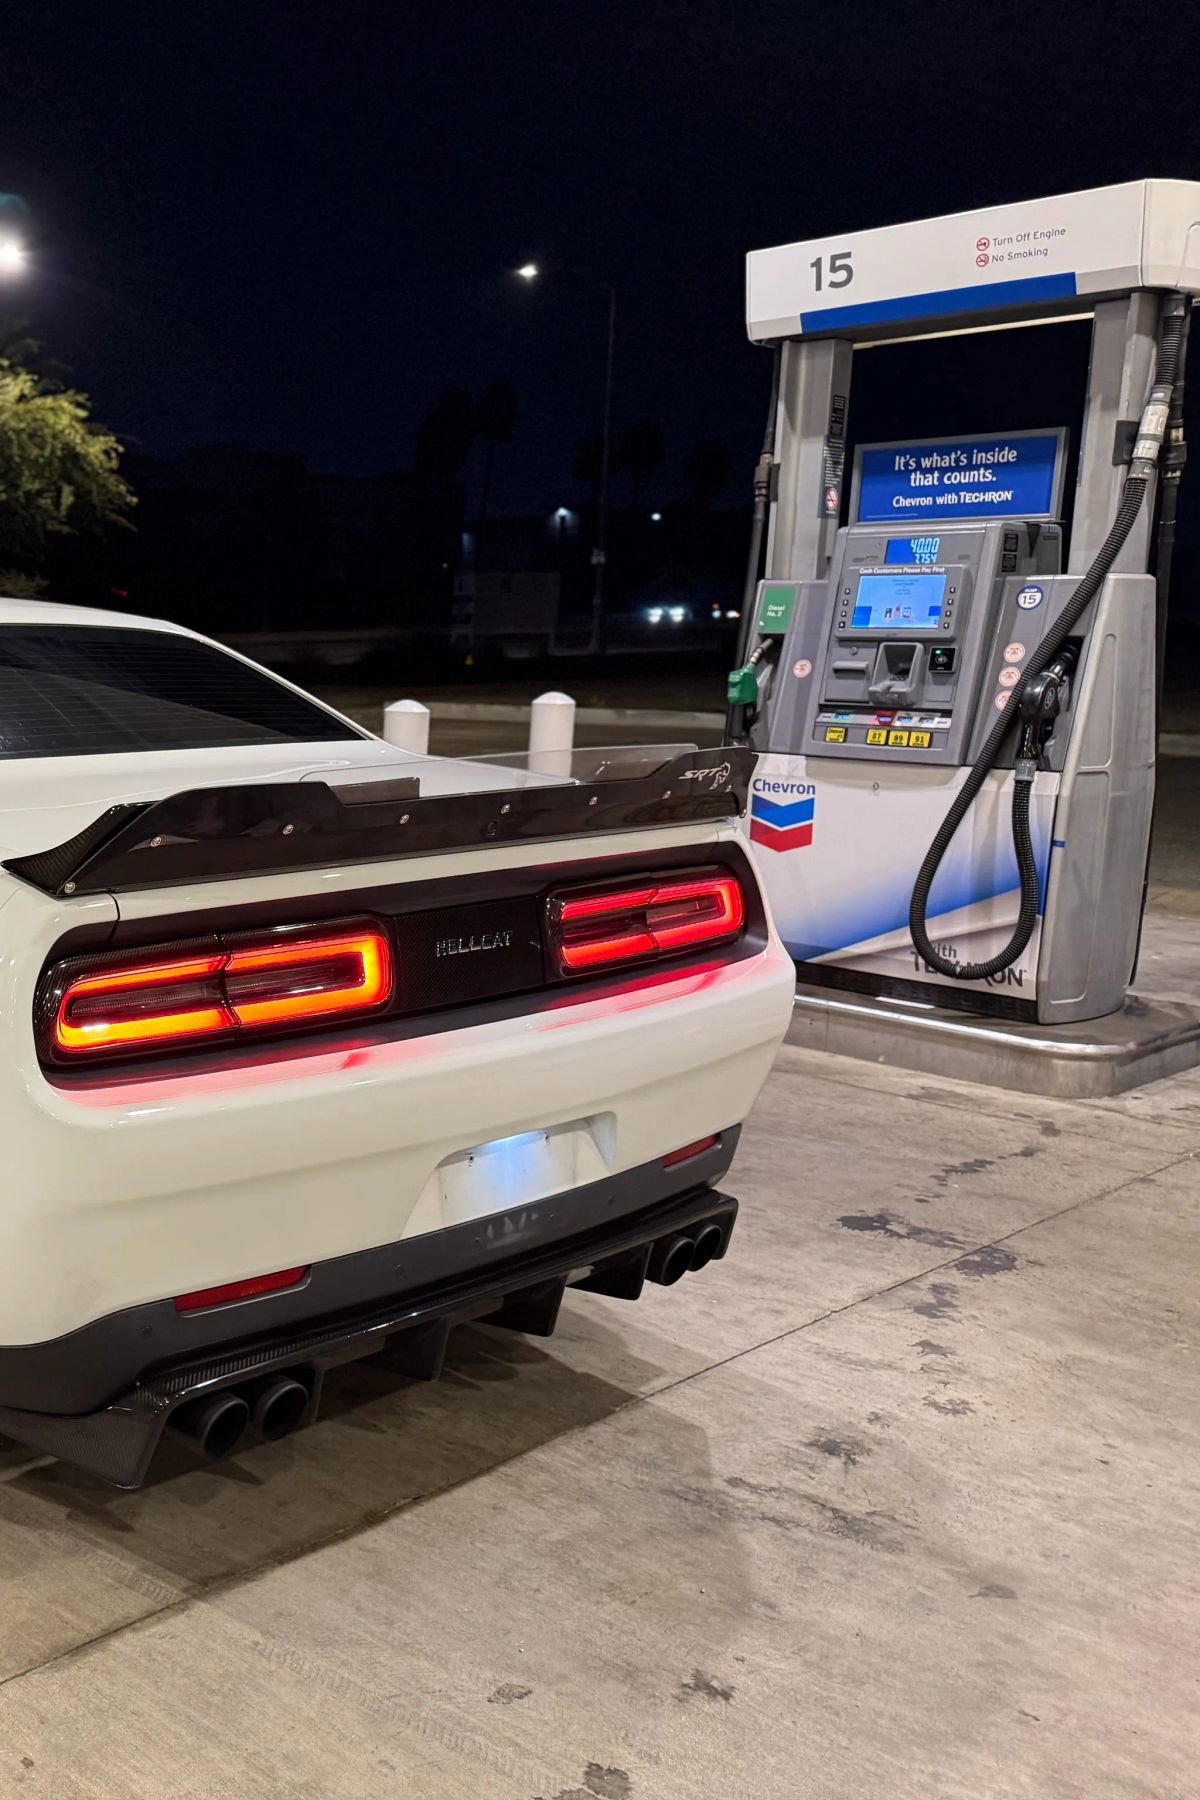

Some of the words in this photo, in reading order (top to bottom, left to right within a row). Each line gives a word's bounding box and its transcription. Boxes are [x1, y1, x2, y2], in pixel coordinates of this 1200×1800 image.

[992, 236, 1013, 247] Turn
[1016, 232, 1031, 243] Off
[1033, 228, 1066, 240] Engine
[991, 254, 1005, 263] No
[1007, 248, 1048, 260] Smoking
[810, 251, 854, 292] 15
[894, 454, 917, 471] It's
[921, 450, 968, 469] what's
[972, 446, 1018, 465] inside
[910, 470, 940, 487] that
[943, 467, 997, 485] counts.
[892, 495, 933, 508] Chevron
[935, 492, 958, 505] with
[959, 490, 1013, 504] TECHRON
[1023, 594, 1037, 605] 15
[871, 732, 882, 740] 87
[893, 734, 904, 742] 89
[678, 767, 722, 781] SRT
[752, 778, 816, 795] Chevron
[436, 930, 513, 957] HELLCAT
[932, 943, 957, 958] ith
